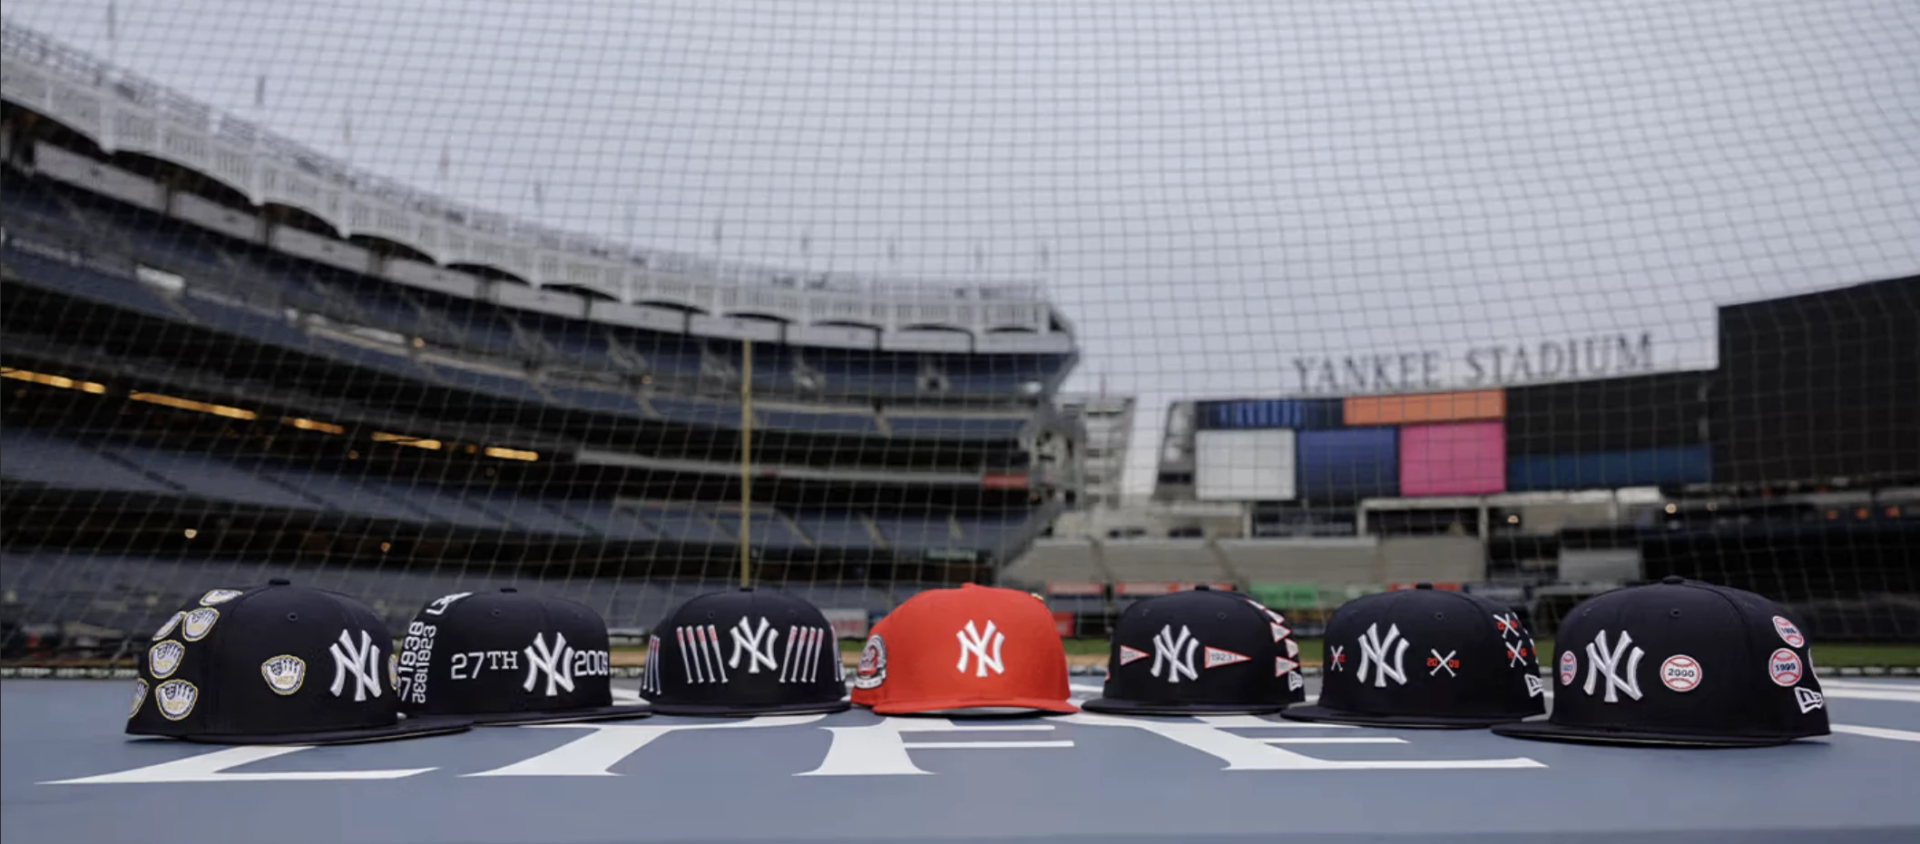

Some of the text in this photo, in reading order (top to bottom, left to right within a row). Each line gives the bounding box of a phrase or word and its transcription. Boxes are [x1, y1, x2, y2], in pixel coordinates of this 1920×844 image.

[1293, 332, 1653, 393] YANKEE STADIUM
[329, 628, 382, 702] NY
[523, 631, 576, 697] NY
[728, 615, 778, 673] NY
[957, 620, 1005, 678] NY
[1150, 624, 1200, 683] NY
[1210, 653, 1233, 662] 1923
[1356, 622, 1411, 688] NY
[1583, 629, 1646, 703] NY
[1667, 667, 1695, 677] 2000
